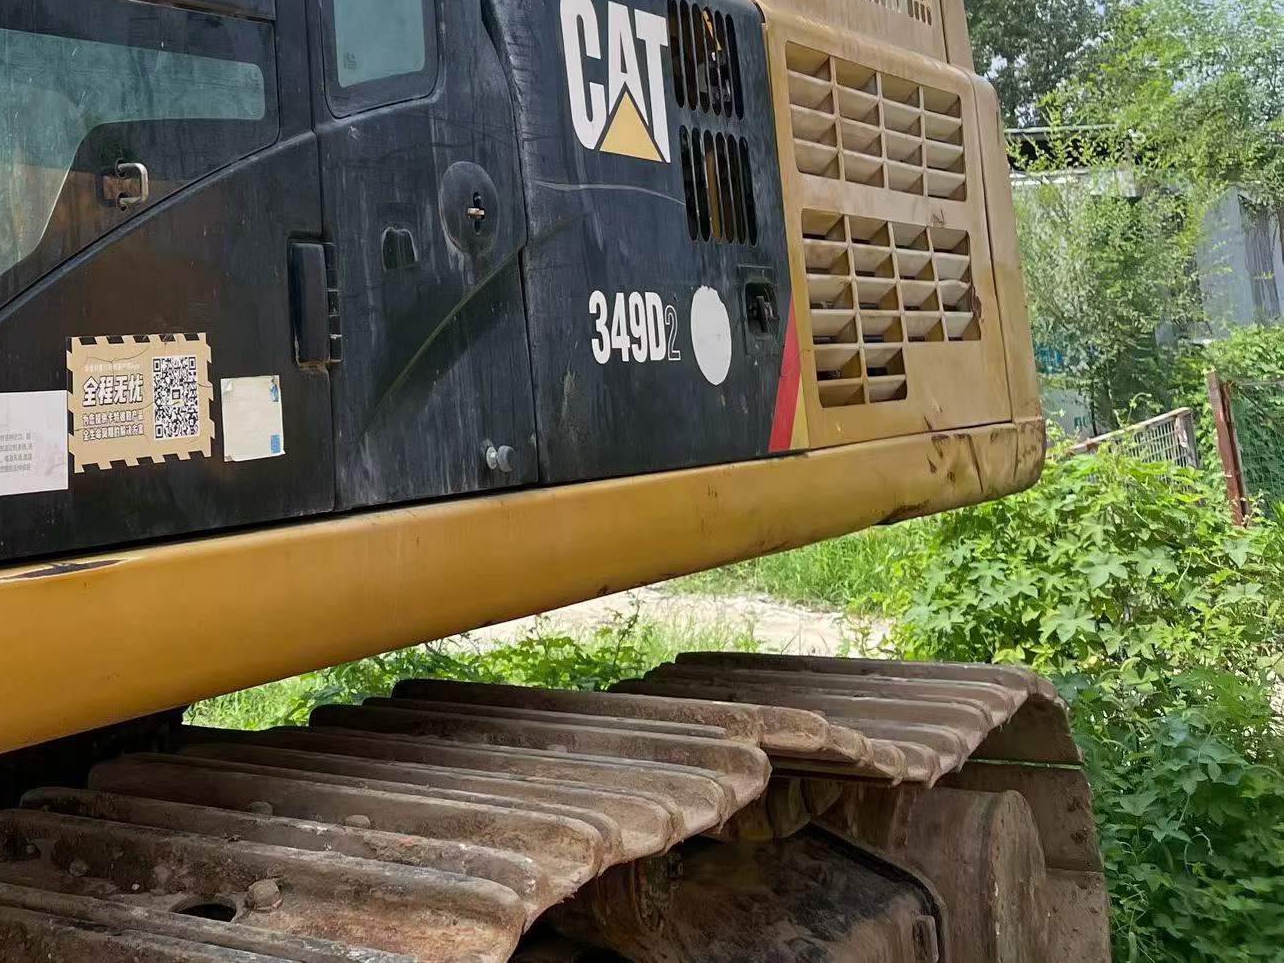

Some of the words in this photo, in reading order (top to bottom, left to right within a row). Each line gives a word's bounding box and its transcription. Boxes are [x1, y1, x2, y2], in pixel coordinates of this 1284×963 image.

[589, 289, 681, 365] 349D2
[82, 375, 144, 407] 全程无忧
